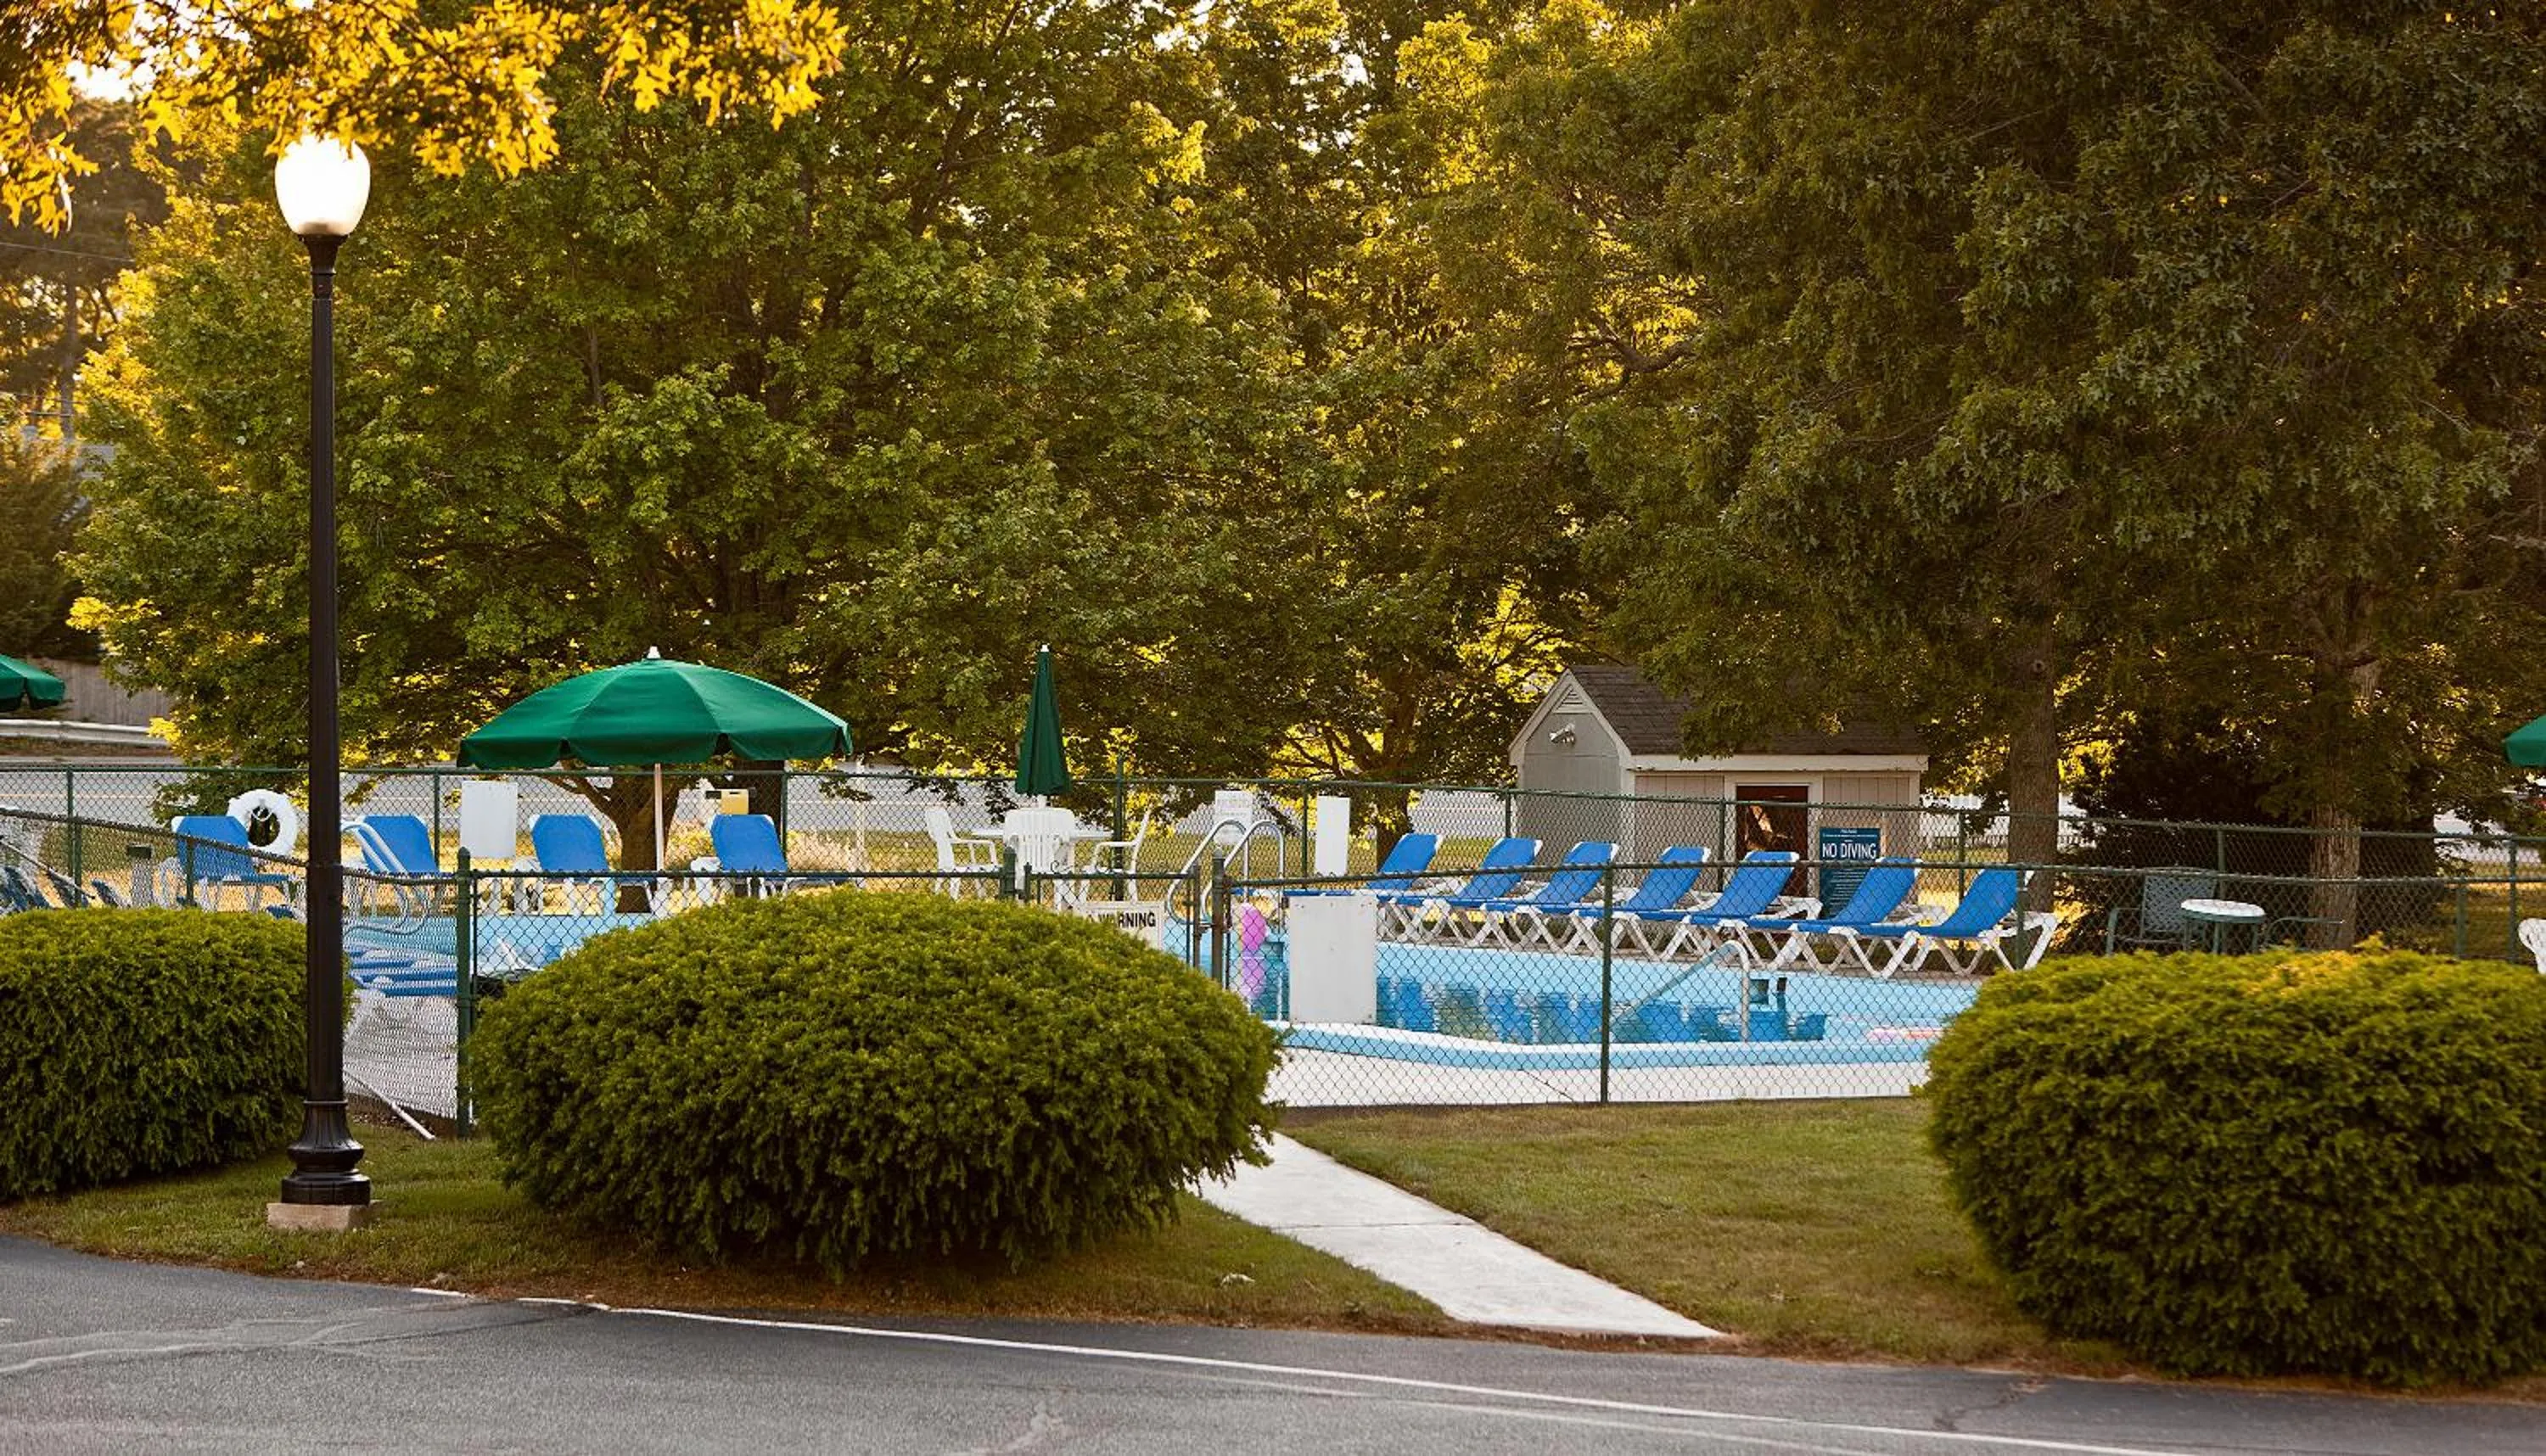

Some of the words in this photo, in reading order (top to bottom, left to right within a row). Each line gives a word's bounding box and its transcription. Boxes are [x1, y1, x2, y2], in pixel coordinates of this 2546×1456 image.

[1822, 843, 1837, 858] NO
[1841, 843, 1876, 859] DIVING
[1097, 912, 1156, 927] WRNING
